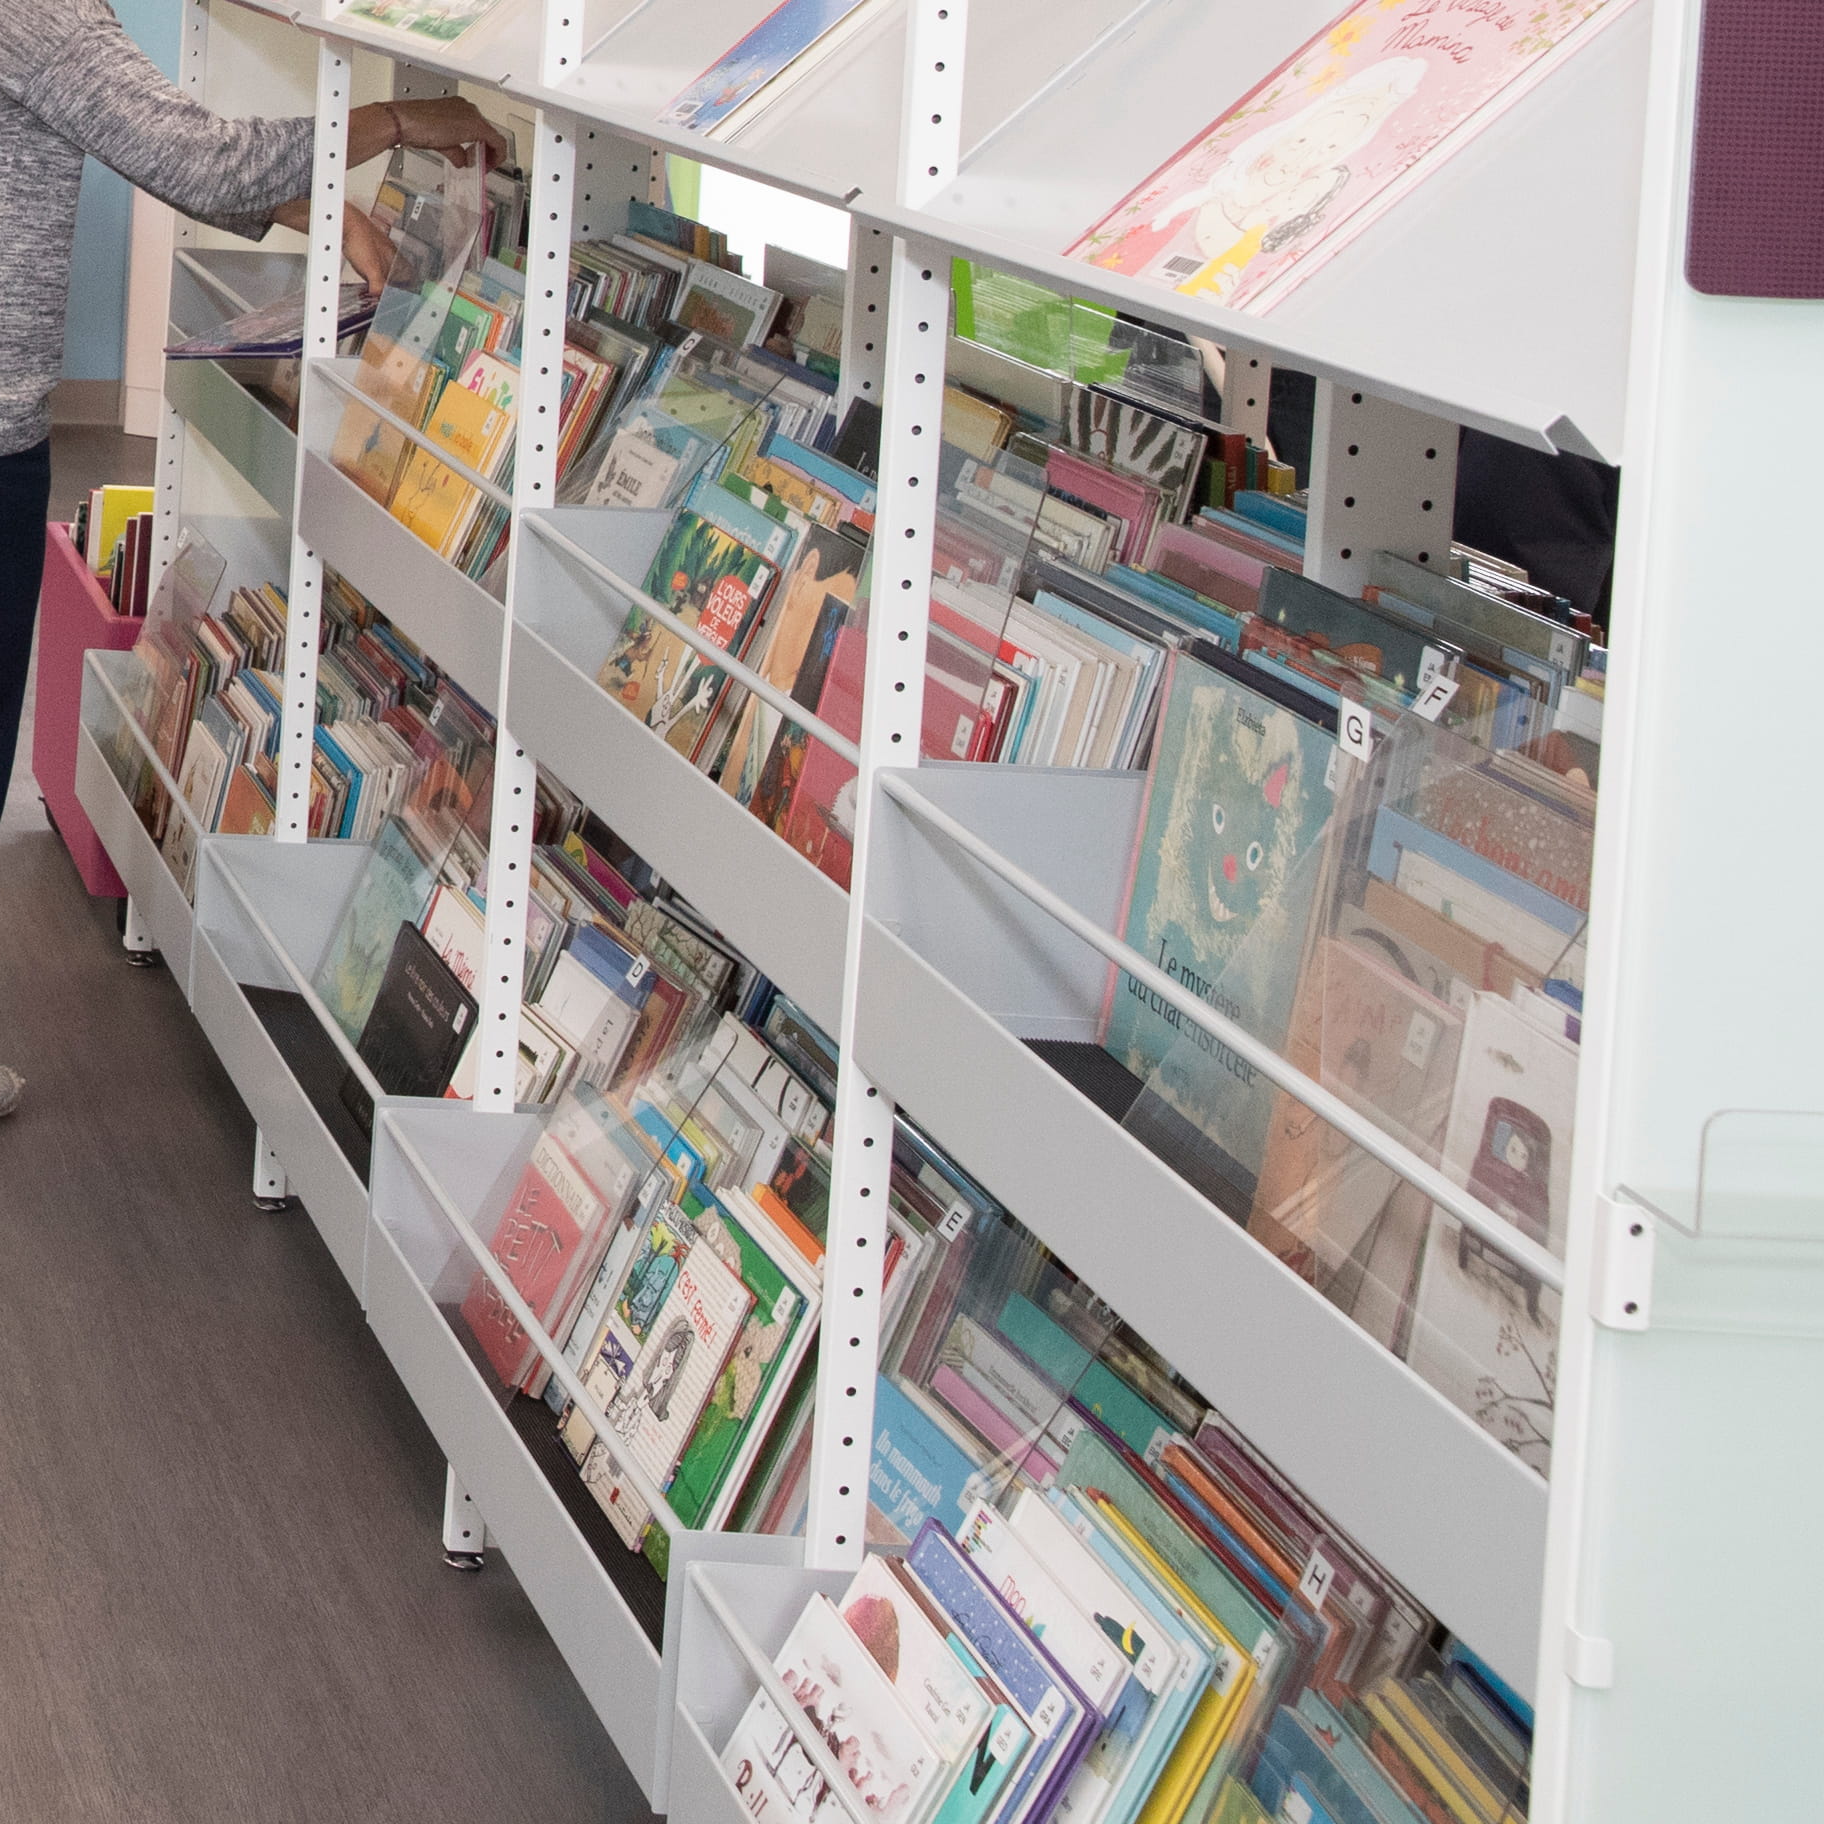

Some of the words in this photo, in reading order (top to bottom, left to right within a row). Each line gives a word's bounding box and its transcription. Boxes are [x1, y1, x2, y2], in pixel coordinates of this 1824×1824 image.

[683, 338, 696, 351] C
[616, 468, 642, 497] ÉMILE
[716, 579, 747, 610] L'OURS
[706, 592, 743, 630] VOLEUR
[1424, 686, 1449, 706] F
[1346, 714, 1363, 747] G
[632, 962, 644, 978] D
[946, 1211, 964, 1232] E
[870, 1459, 893, 1495] dans
[889, 1479, 902, 1503] le
[875, 1428, 891, 1455] Un
[887, 1447, 943, 1508] mammouth
[1307, 1563, 1327, 1595] H
